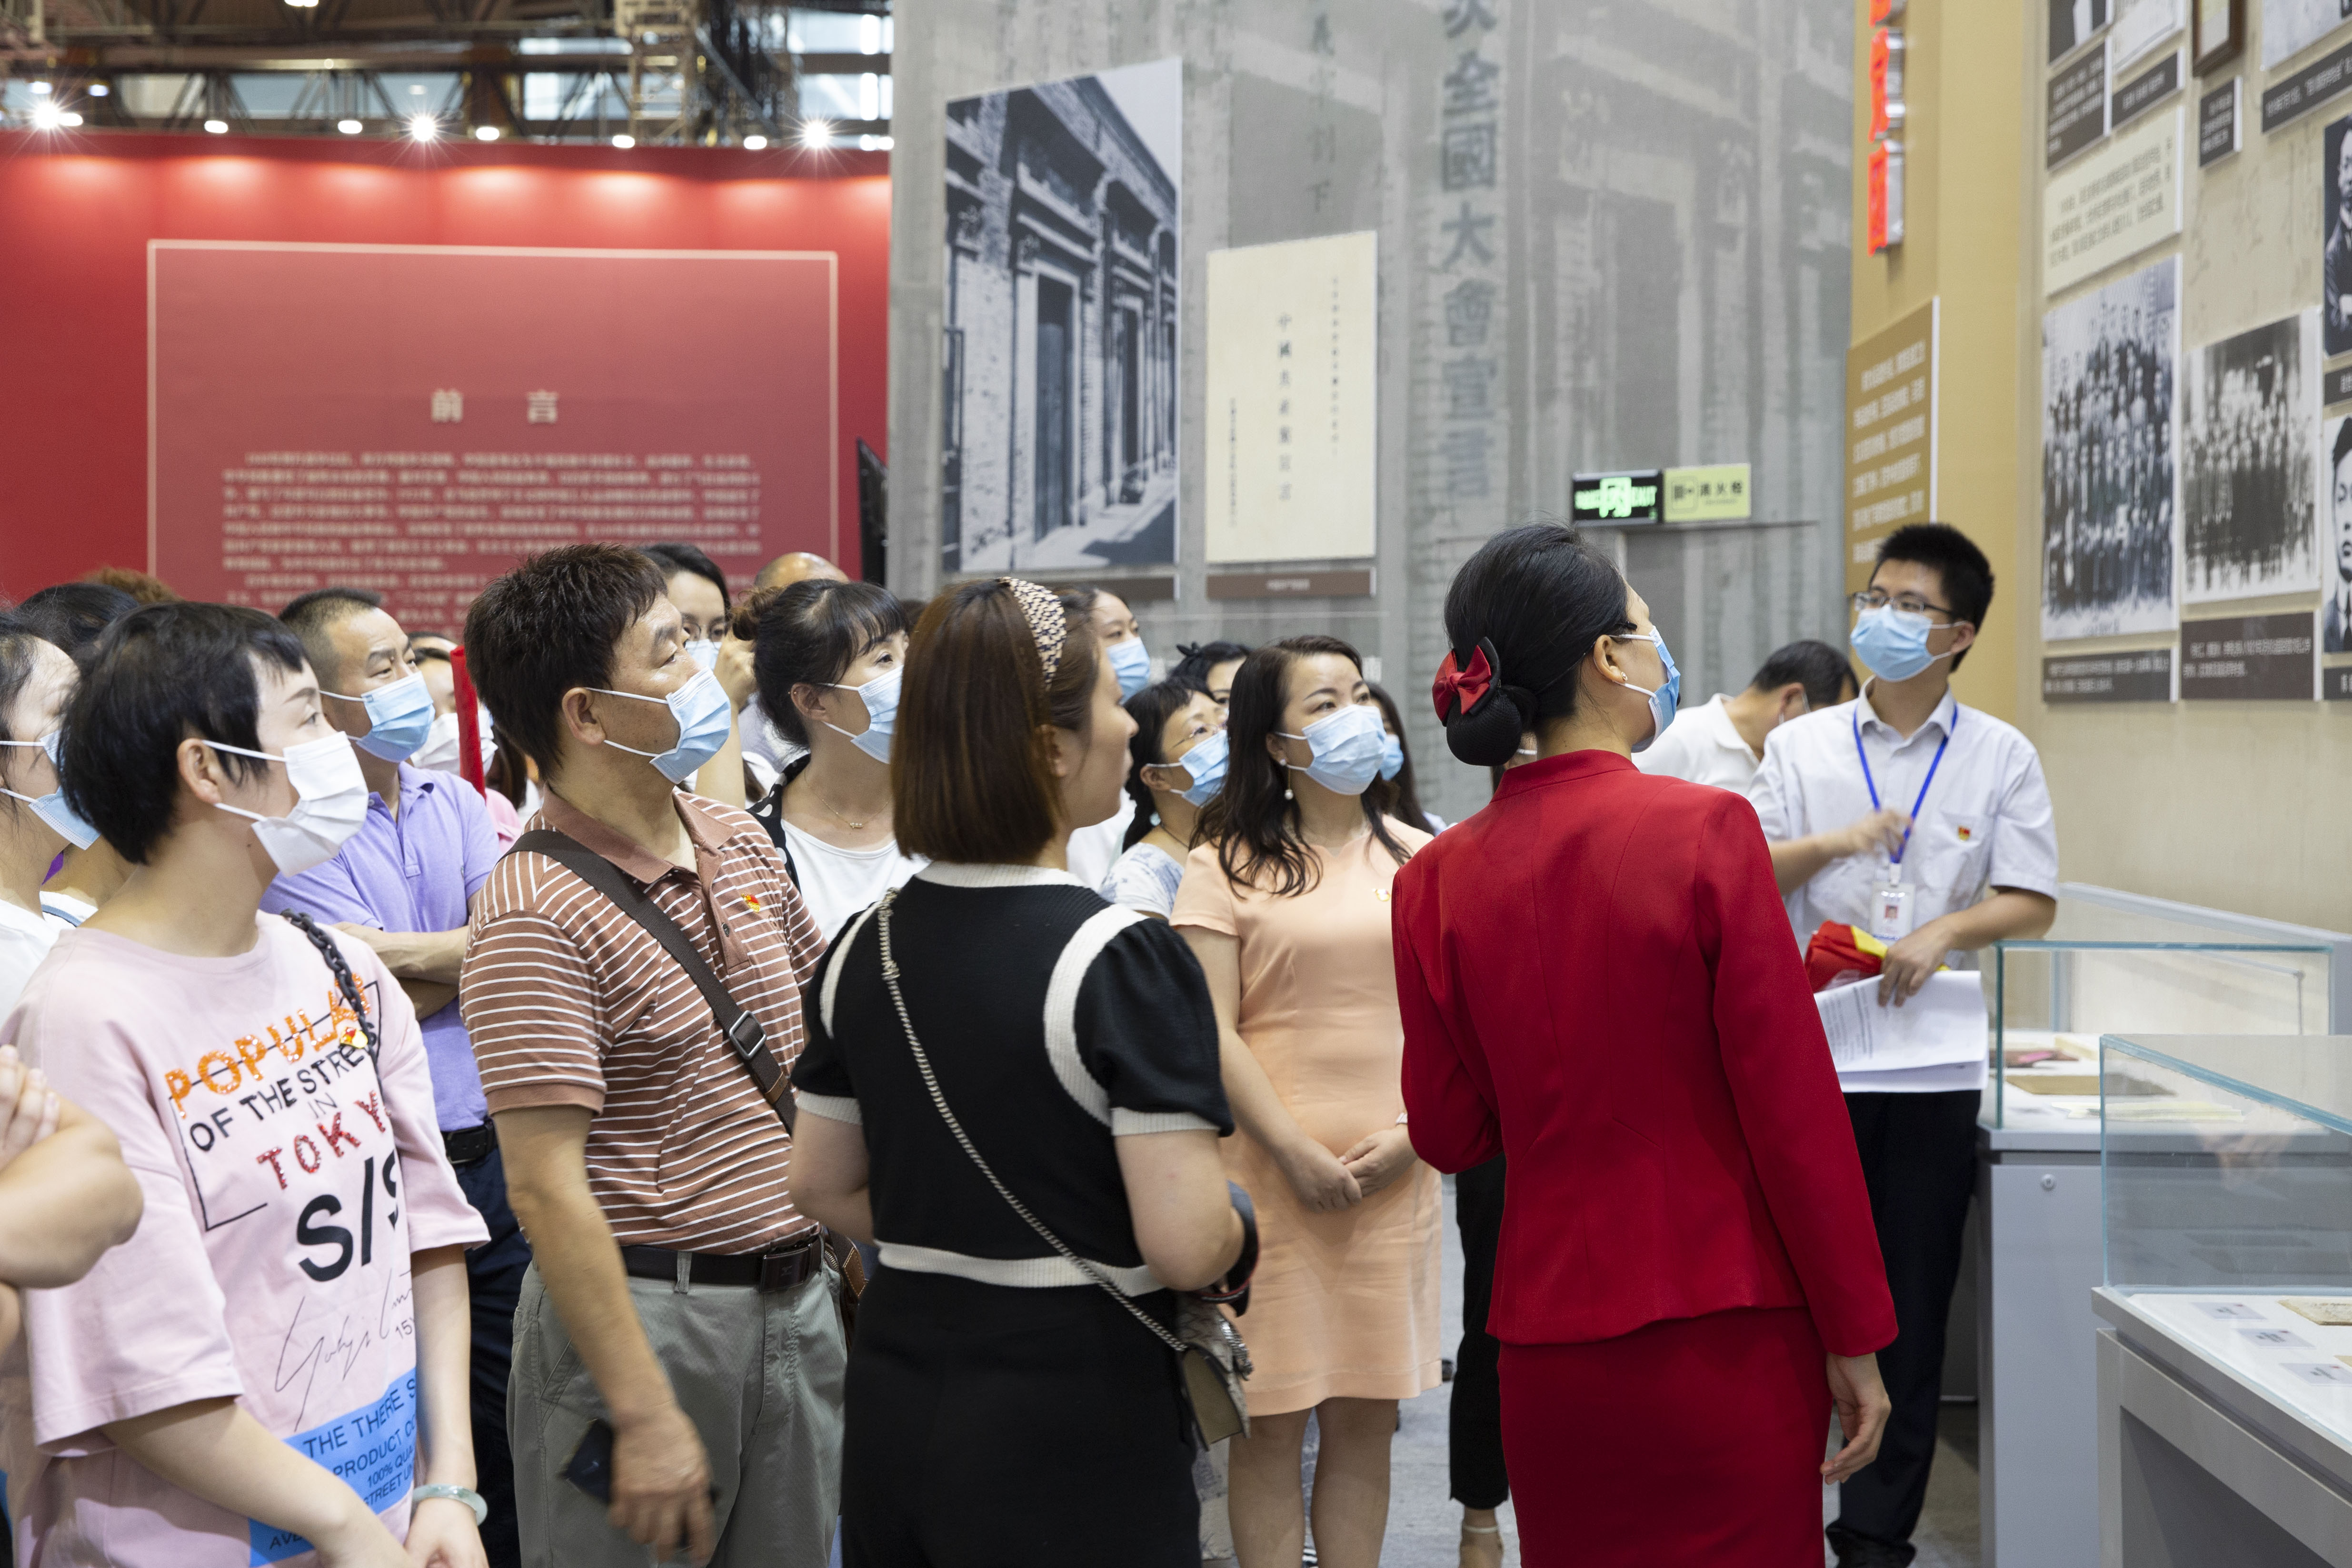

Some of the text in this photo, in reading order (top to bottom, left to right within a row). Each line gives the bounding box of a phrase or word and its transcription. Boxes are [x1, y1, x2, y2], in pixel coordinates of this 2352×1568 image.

[190, 1107, 234, 1151] OF
[239, 1077, 298, 1120] THE
[308, 1093, 338, 1119] IN
[256, 1089, 392, 1190] TOKY
[303, 1424, 348, 1459] THE
[351, 1388, 405, 1439] THERE
[333, 1428, 401, 1478] PRODUCT
[368, 1462, 393, 1488] 100%
